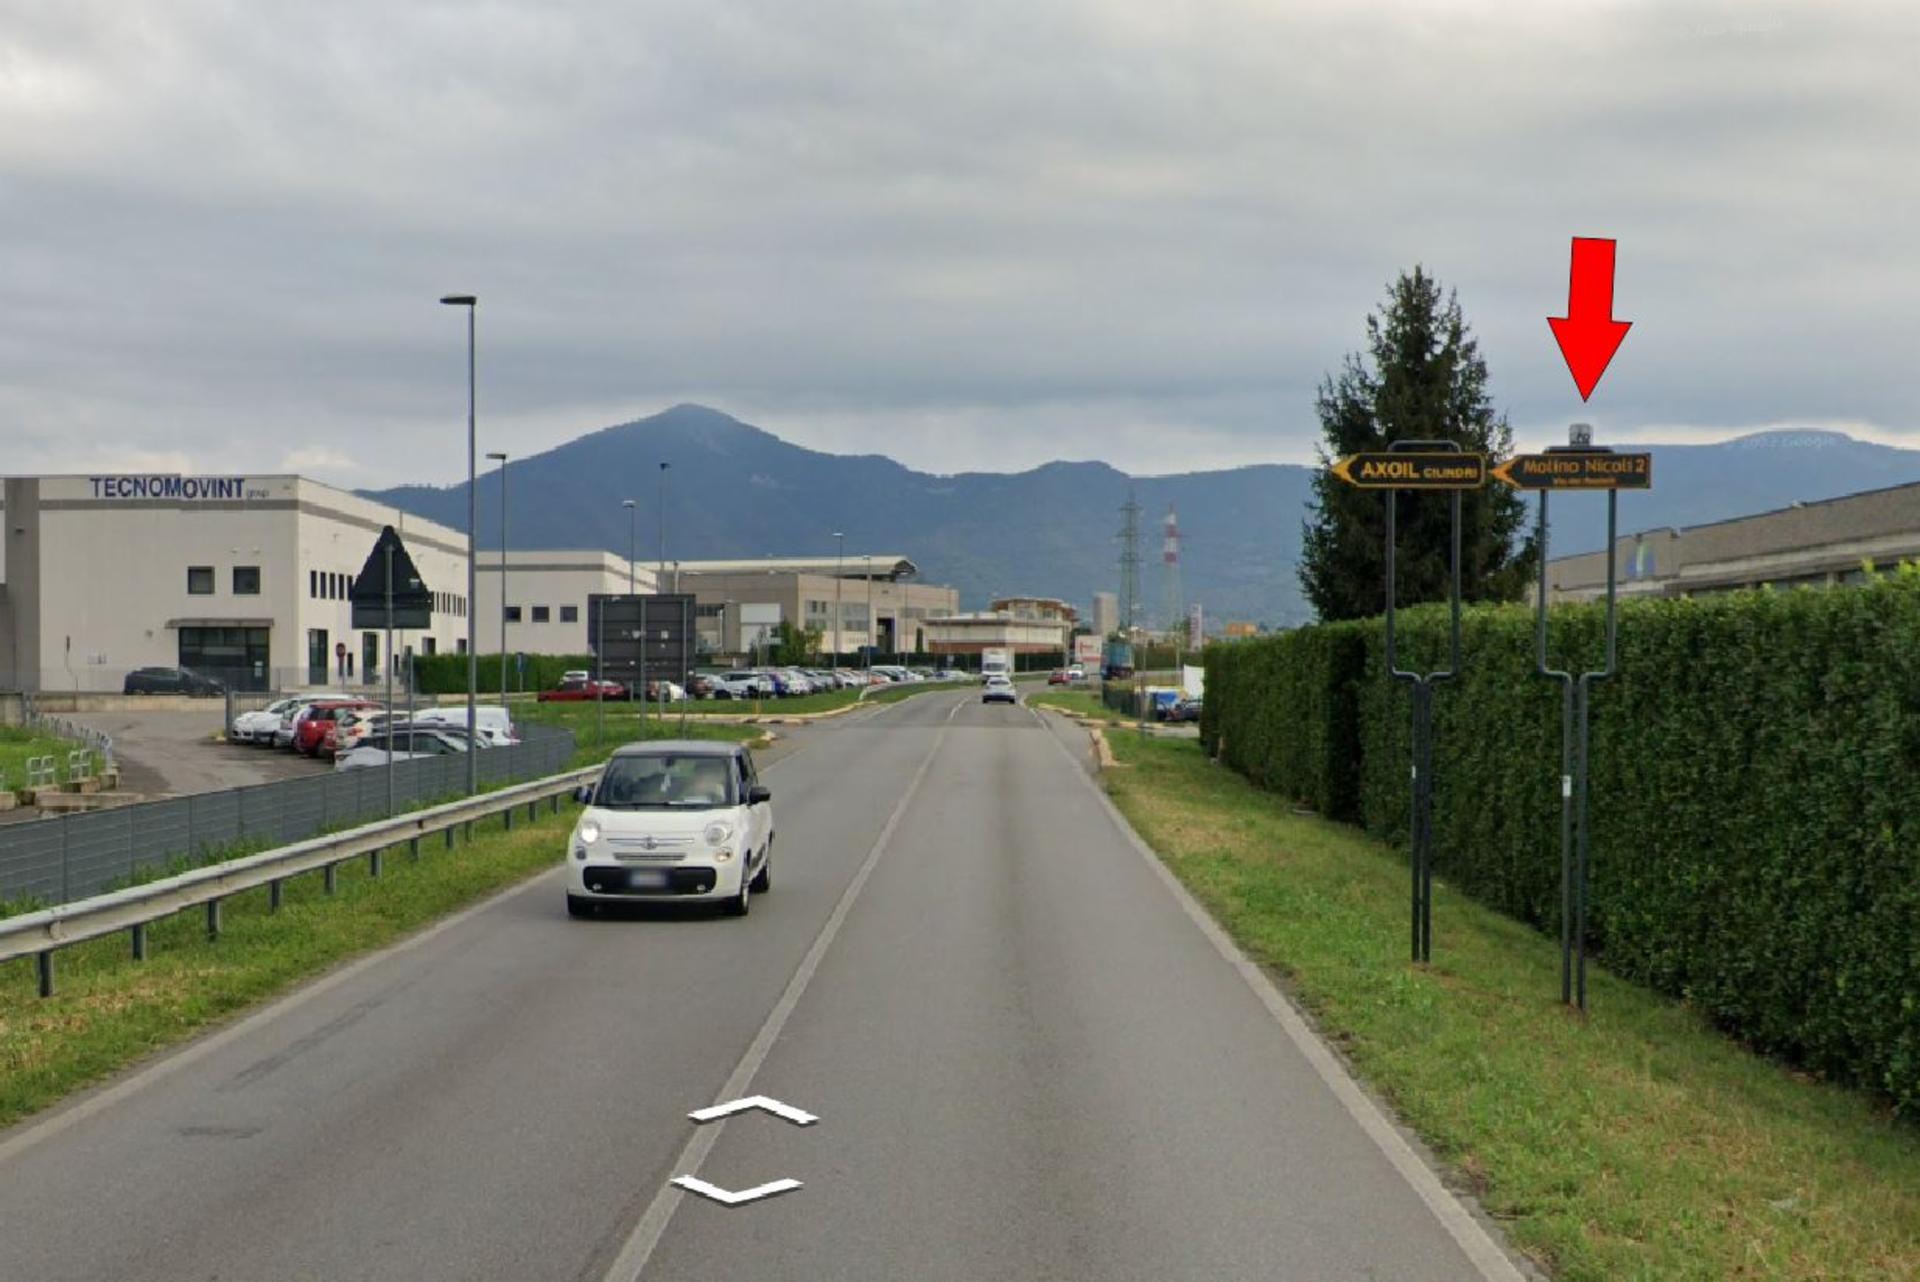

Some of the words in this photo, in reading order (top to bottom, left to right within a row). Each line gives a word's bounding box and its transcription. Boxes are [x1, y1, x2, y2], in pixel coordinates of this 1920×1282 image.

[1360, 461, 1420, 478] AXOIL
[1523, 458, 1579, 475] Molino
[1585, 458, 1632, 474] Nicoli
[1635, 458, 1646, 473] 2
[90, 477, 245, 499] TECNOMOVINT
